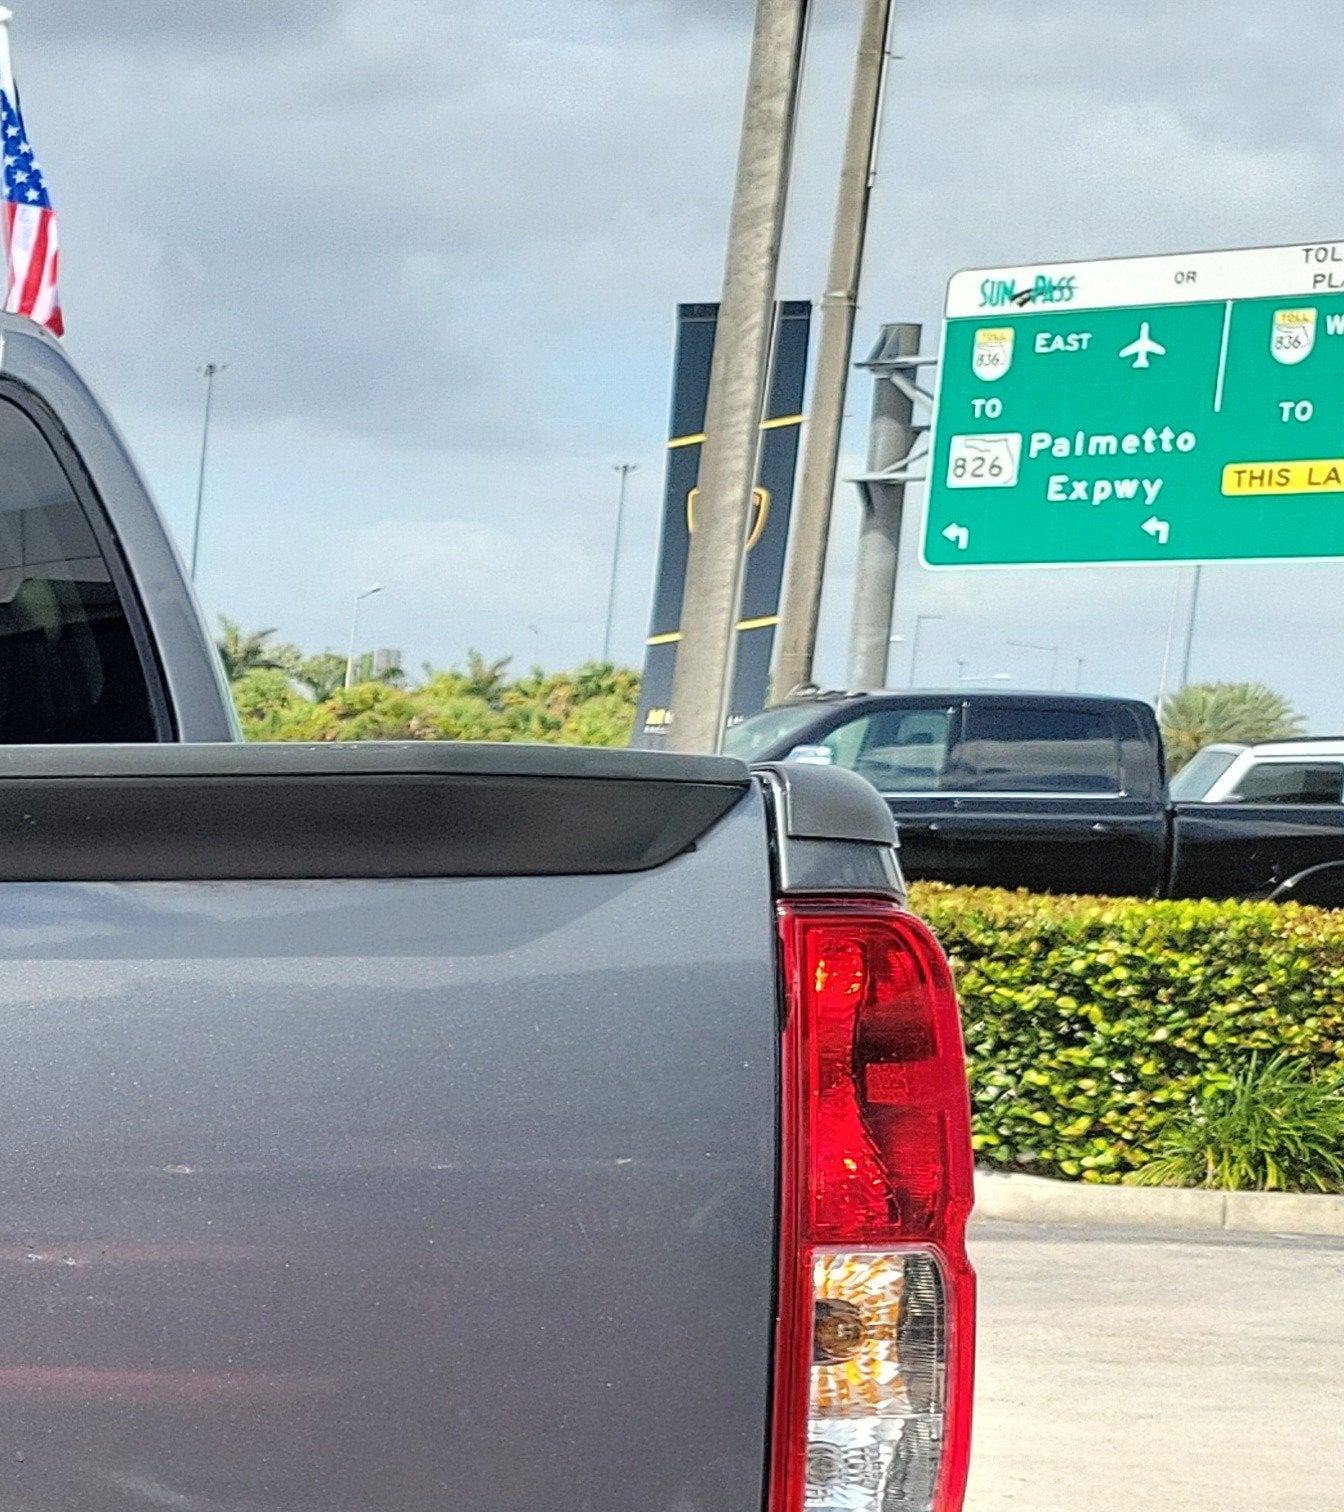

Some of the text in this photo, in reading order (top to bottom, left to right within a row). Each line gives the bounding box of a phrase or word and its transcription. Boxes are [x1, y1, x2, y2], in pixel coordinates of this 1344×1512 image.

[1174, 271, 1197, 285] OR
[1035, 331, 1092, 353] EAST
[1275, 335, 1301, 350] 836
[971, 398, 1003, 418] TO
[1279, 400, 1313, 422] TO
[1029, 426, 1197, 458] Palmetto
[952, 457, 1003, 478] 826
[1233, 468, 1291, 488] THIS
[1047, 474, 1163, 505] Expwy
